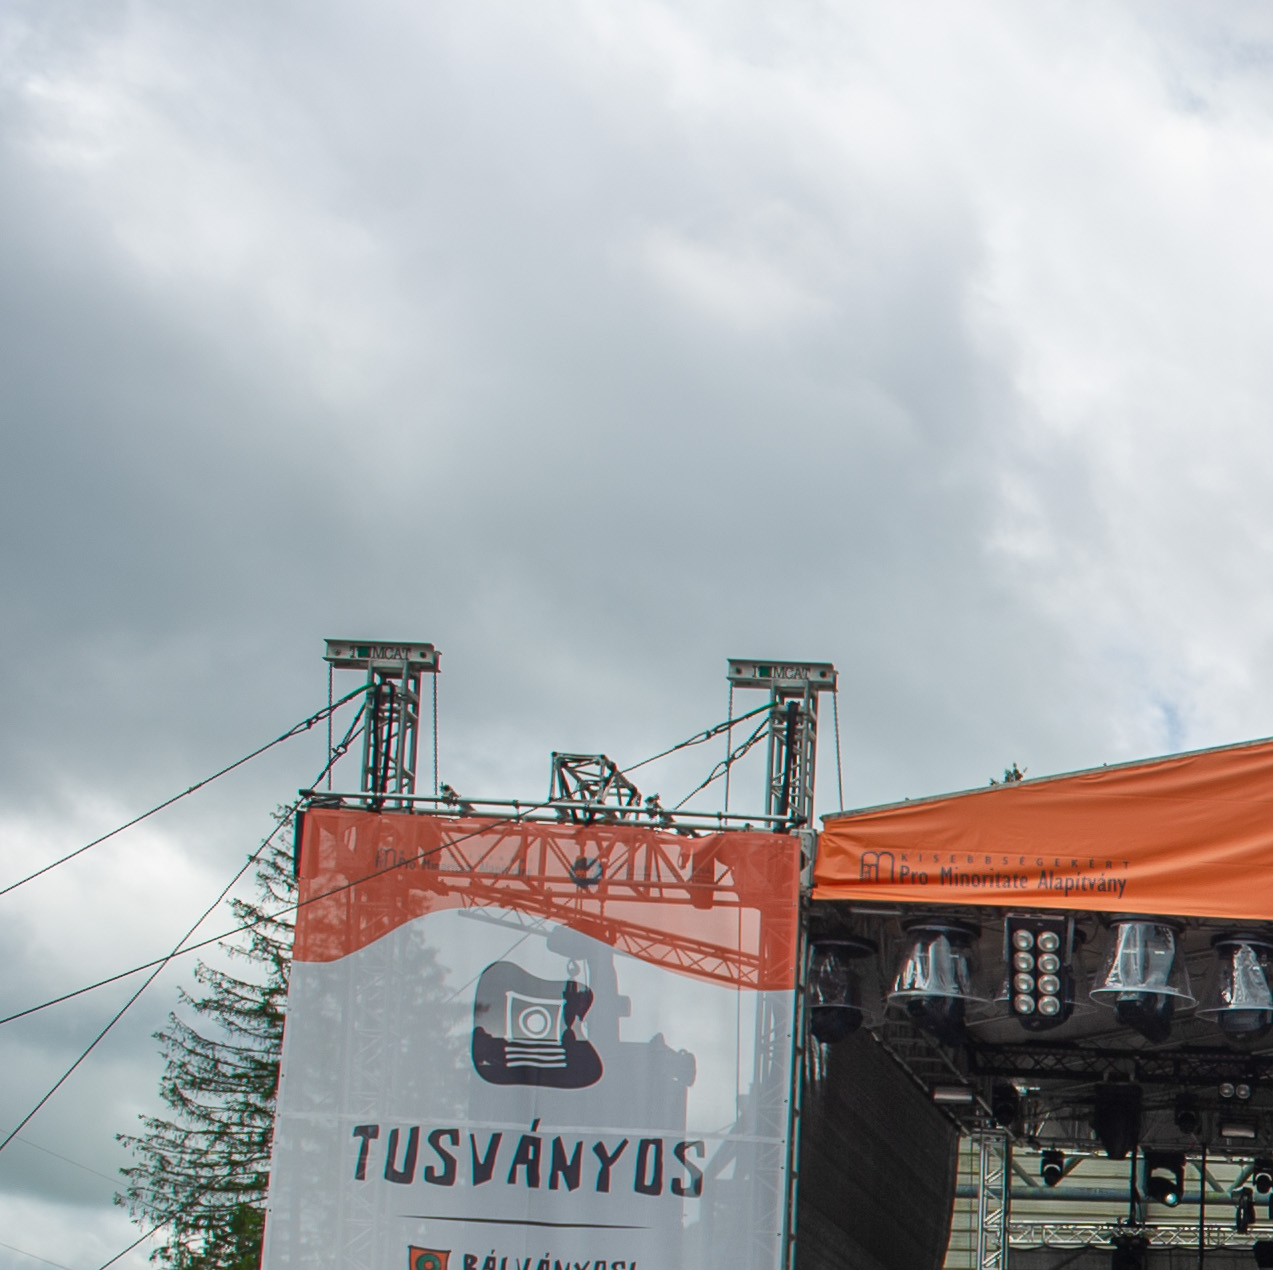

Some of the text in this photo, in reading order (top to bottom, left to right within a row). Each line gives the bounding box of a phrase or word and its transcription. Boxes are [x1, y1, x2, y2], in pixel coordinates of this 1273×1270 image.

[900, 865, 1127, 899] Pro Minoritate Alapítvány
[352, 1118, 706, 1199] TUSVÁNYOS
